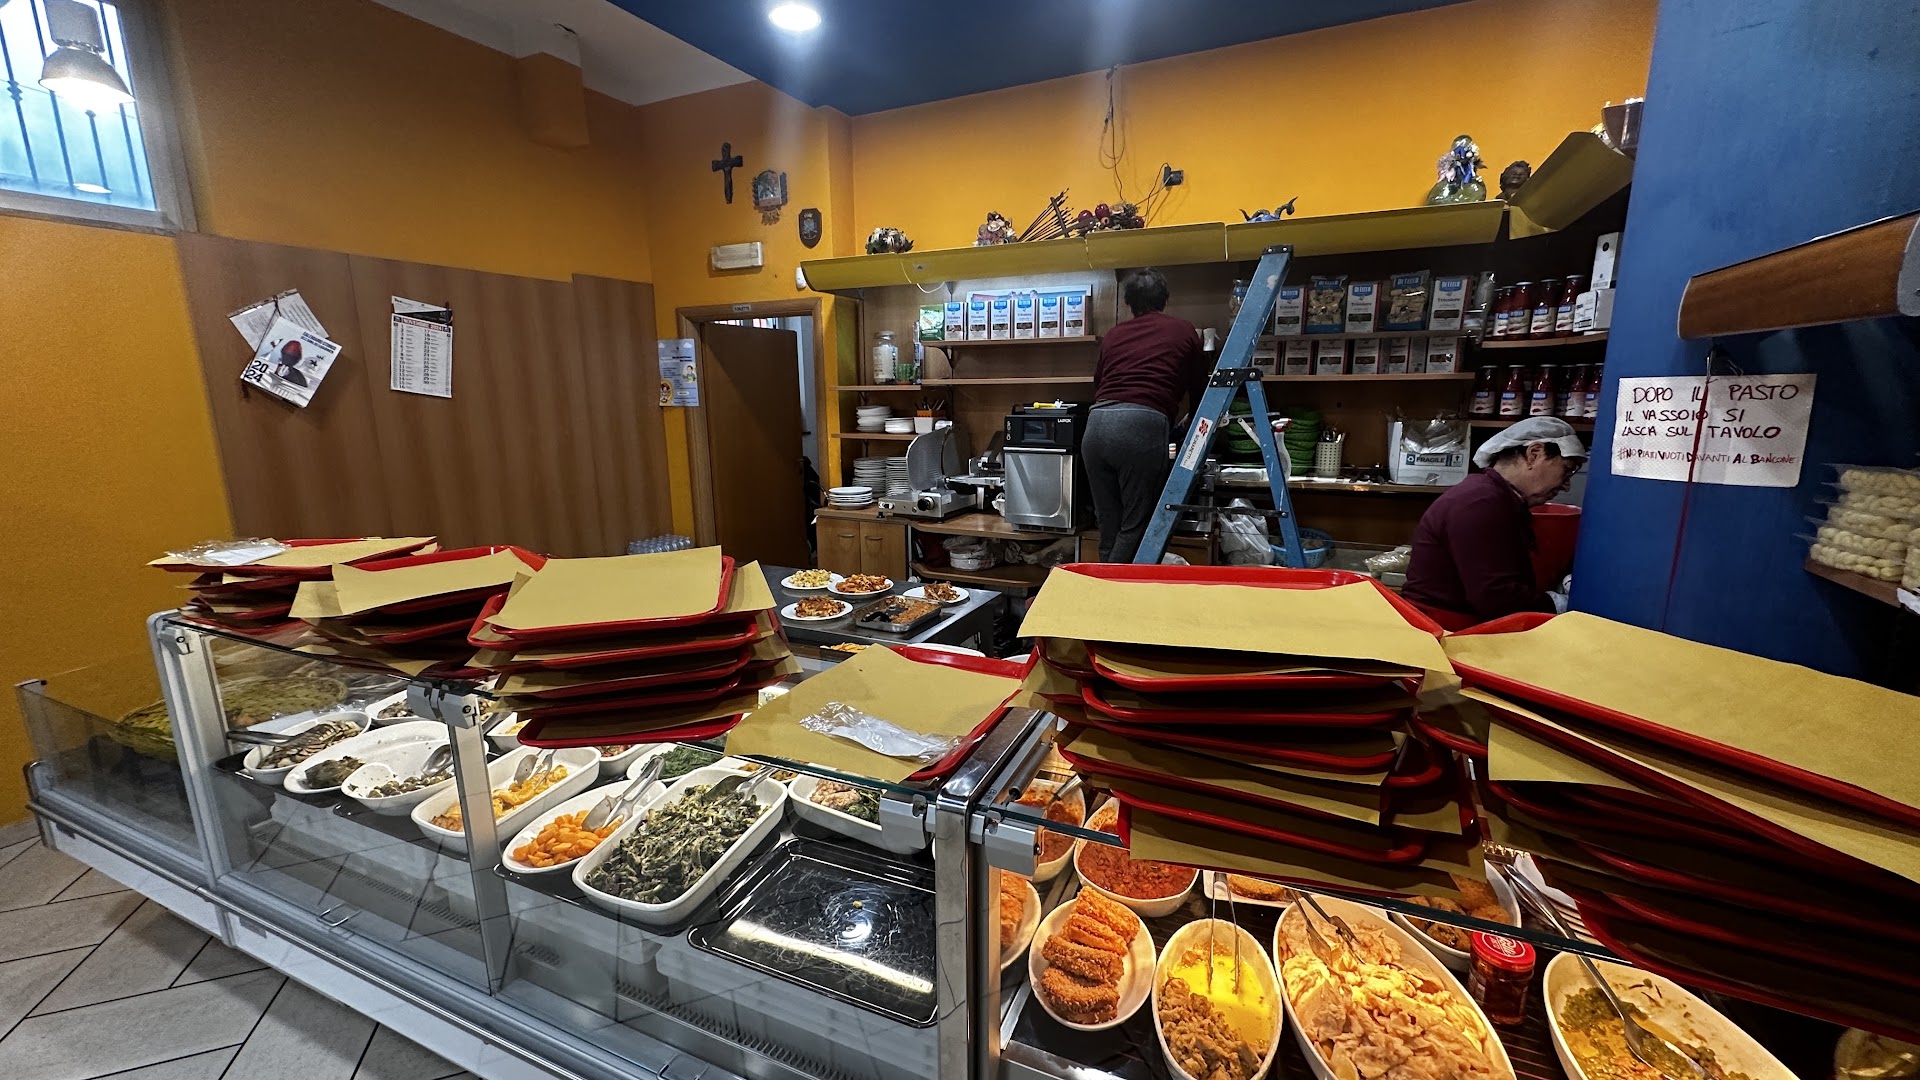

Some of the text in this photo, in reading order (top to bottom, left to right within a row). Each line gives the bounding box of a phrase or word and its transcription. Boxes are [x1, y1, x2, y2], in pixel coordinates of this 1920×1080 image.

[251, 360, 269, 373] 20
[244, 369, 263, 382] 24
[1633, 384, 1799, 404] DOPO IL PASTO
[1625, 408, 1745, 422] IL VASSOIO SI
[1621, 425, 1782, 439] LASCIA SUL TAVOLO
[1416, 455, 1446, 463] FRAGILE
